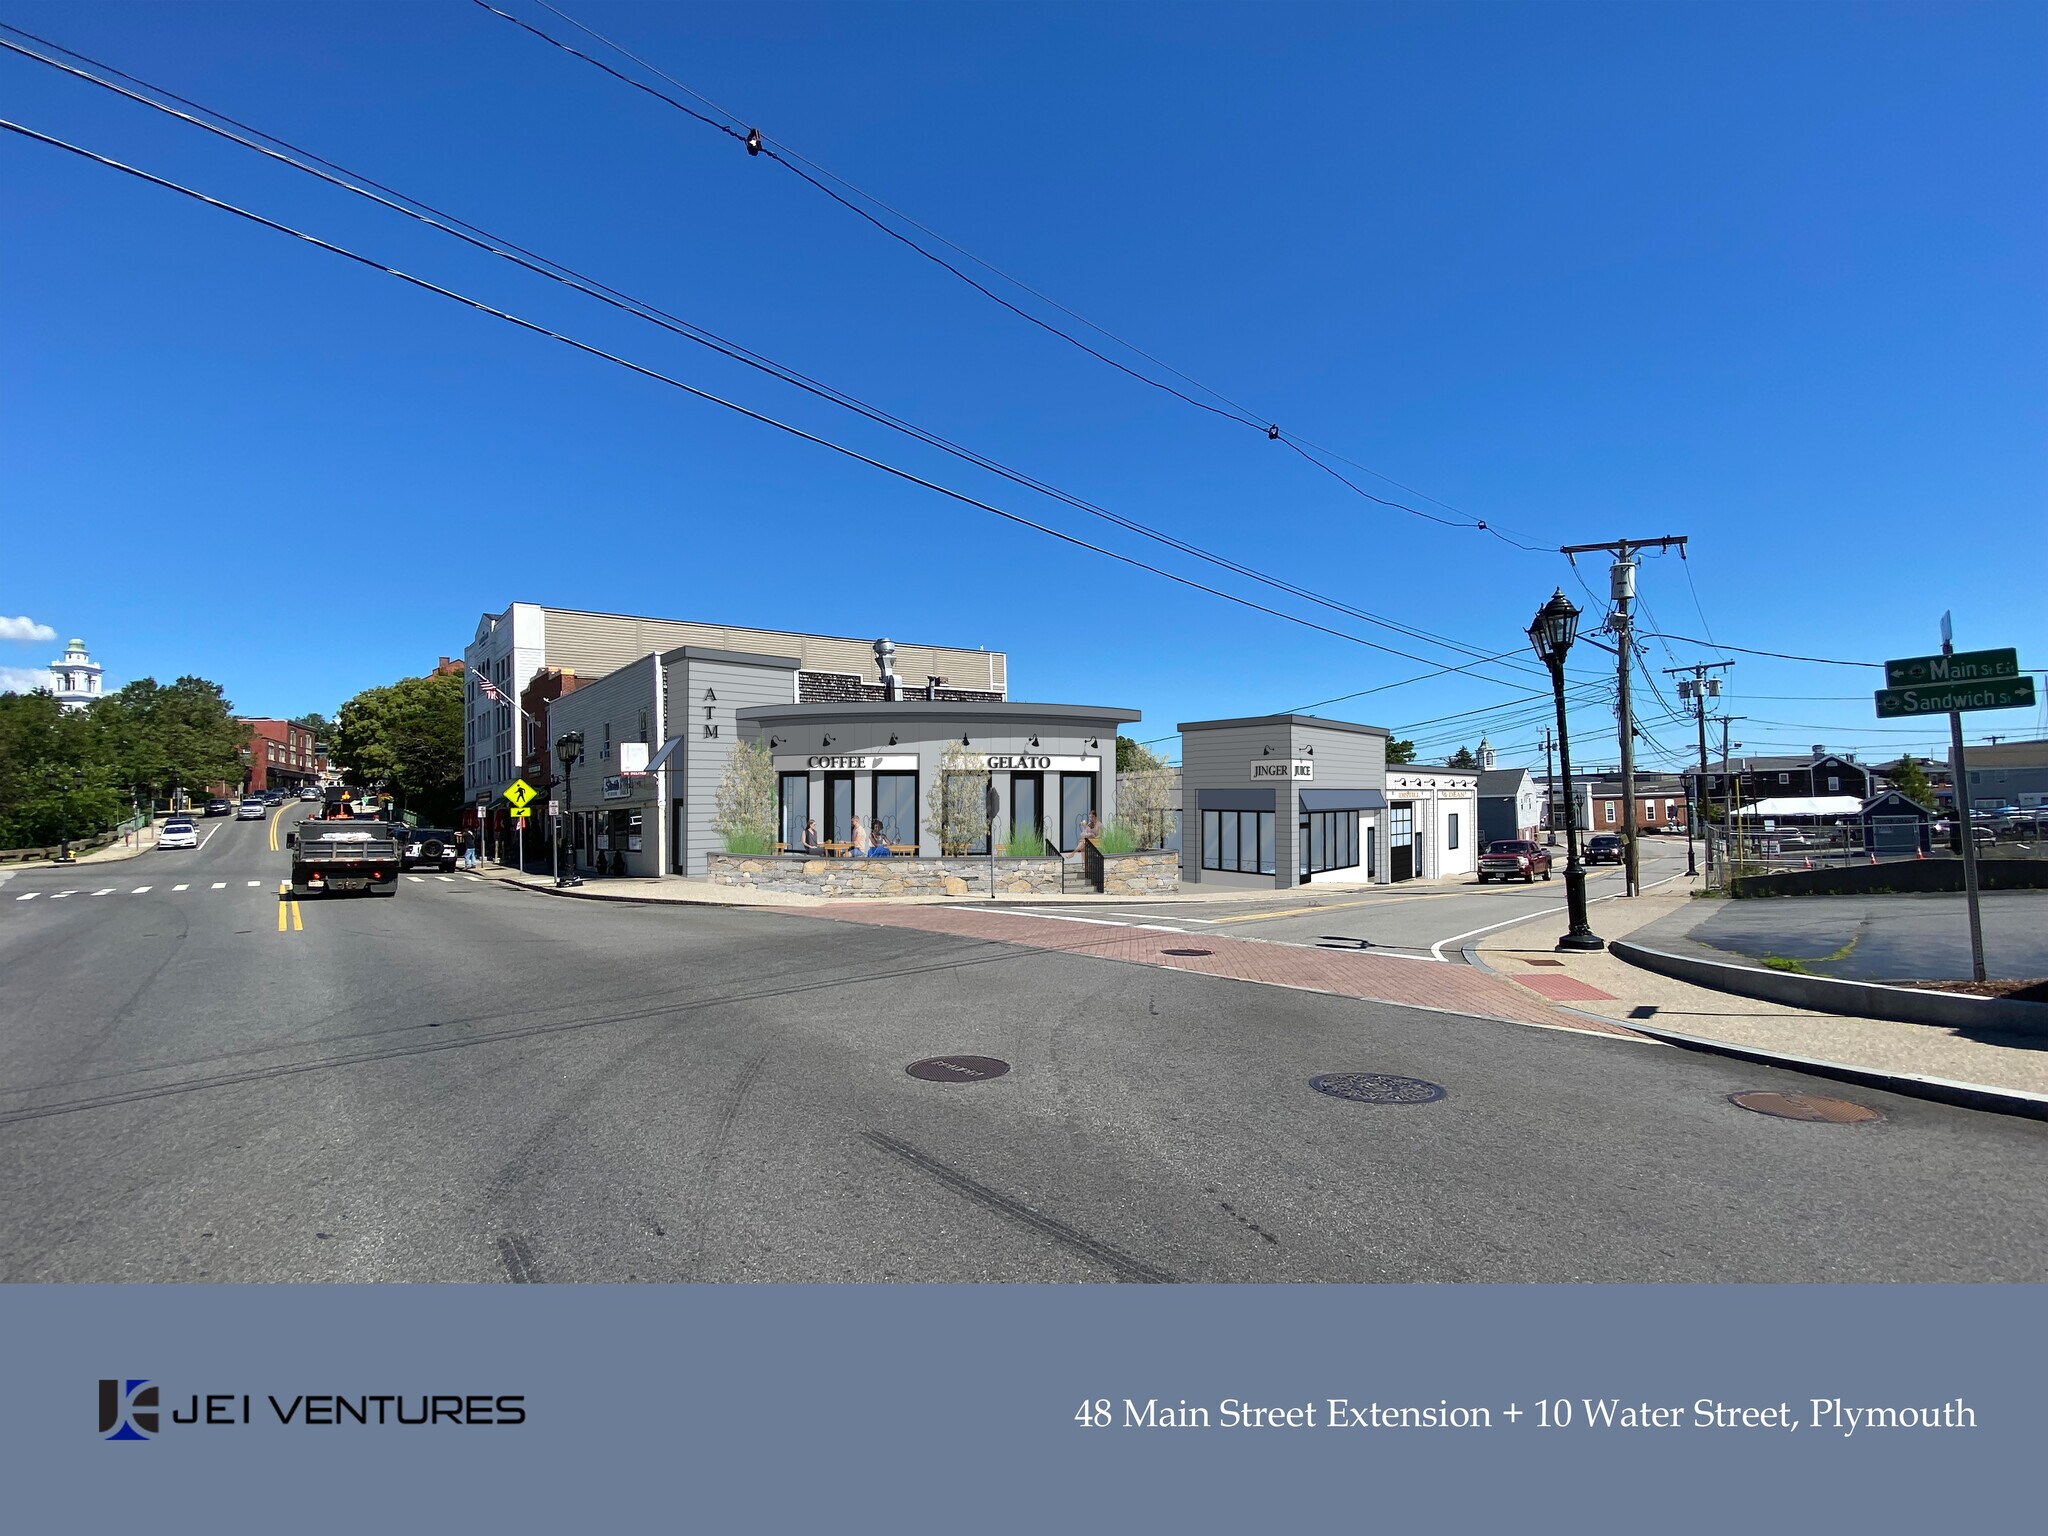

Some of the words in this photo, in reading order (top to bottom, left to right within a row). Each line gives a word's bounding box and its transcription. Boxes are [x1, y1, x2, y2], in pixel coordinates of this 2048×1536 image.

[1929, 658, 1977, 681] Main
[1980, 664, 1992, 676] St
[1903, 690, 1995, 712] Sandwich
[1999, 692, 2012, 704] St
[703, 687, 720, 739] ATM
[807, 755, 866, 769] COFFEE
[987, 756, 1051, 769] GELATO
[1253, 765, 1289, 778] JINGER
[1294, 765, 1311, 777] JUICE
[1448, 790, 1465, 798] DEAN
